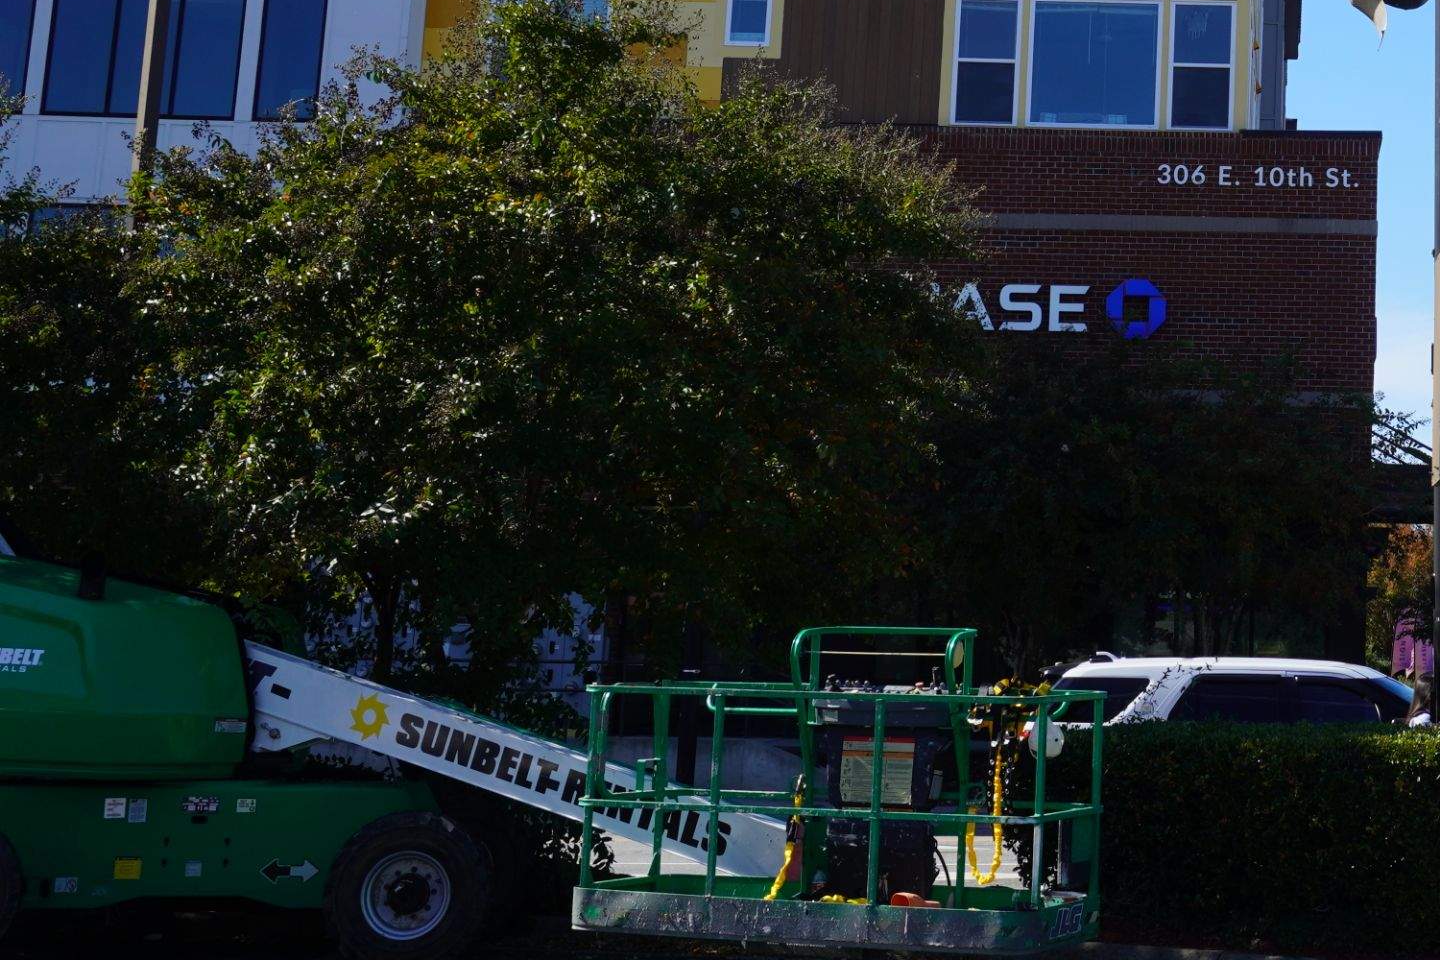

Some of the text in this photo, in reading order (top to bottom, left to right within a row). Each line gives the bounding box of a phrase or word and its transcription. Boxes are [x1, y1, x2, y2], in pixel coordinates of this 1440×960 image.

[1157, 163, 1360, 188] 306 E. 10th St.
[930, 282, 1091, 332] ASE
[0, 647, 45, 666] BELT
[0, 665, 27, 673] ALS
